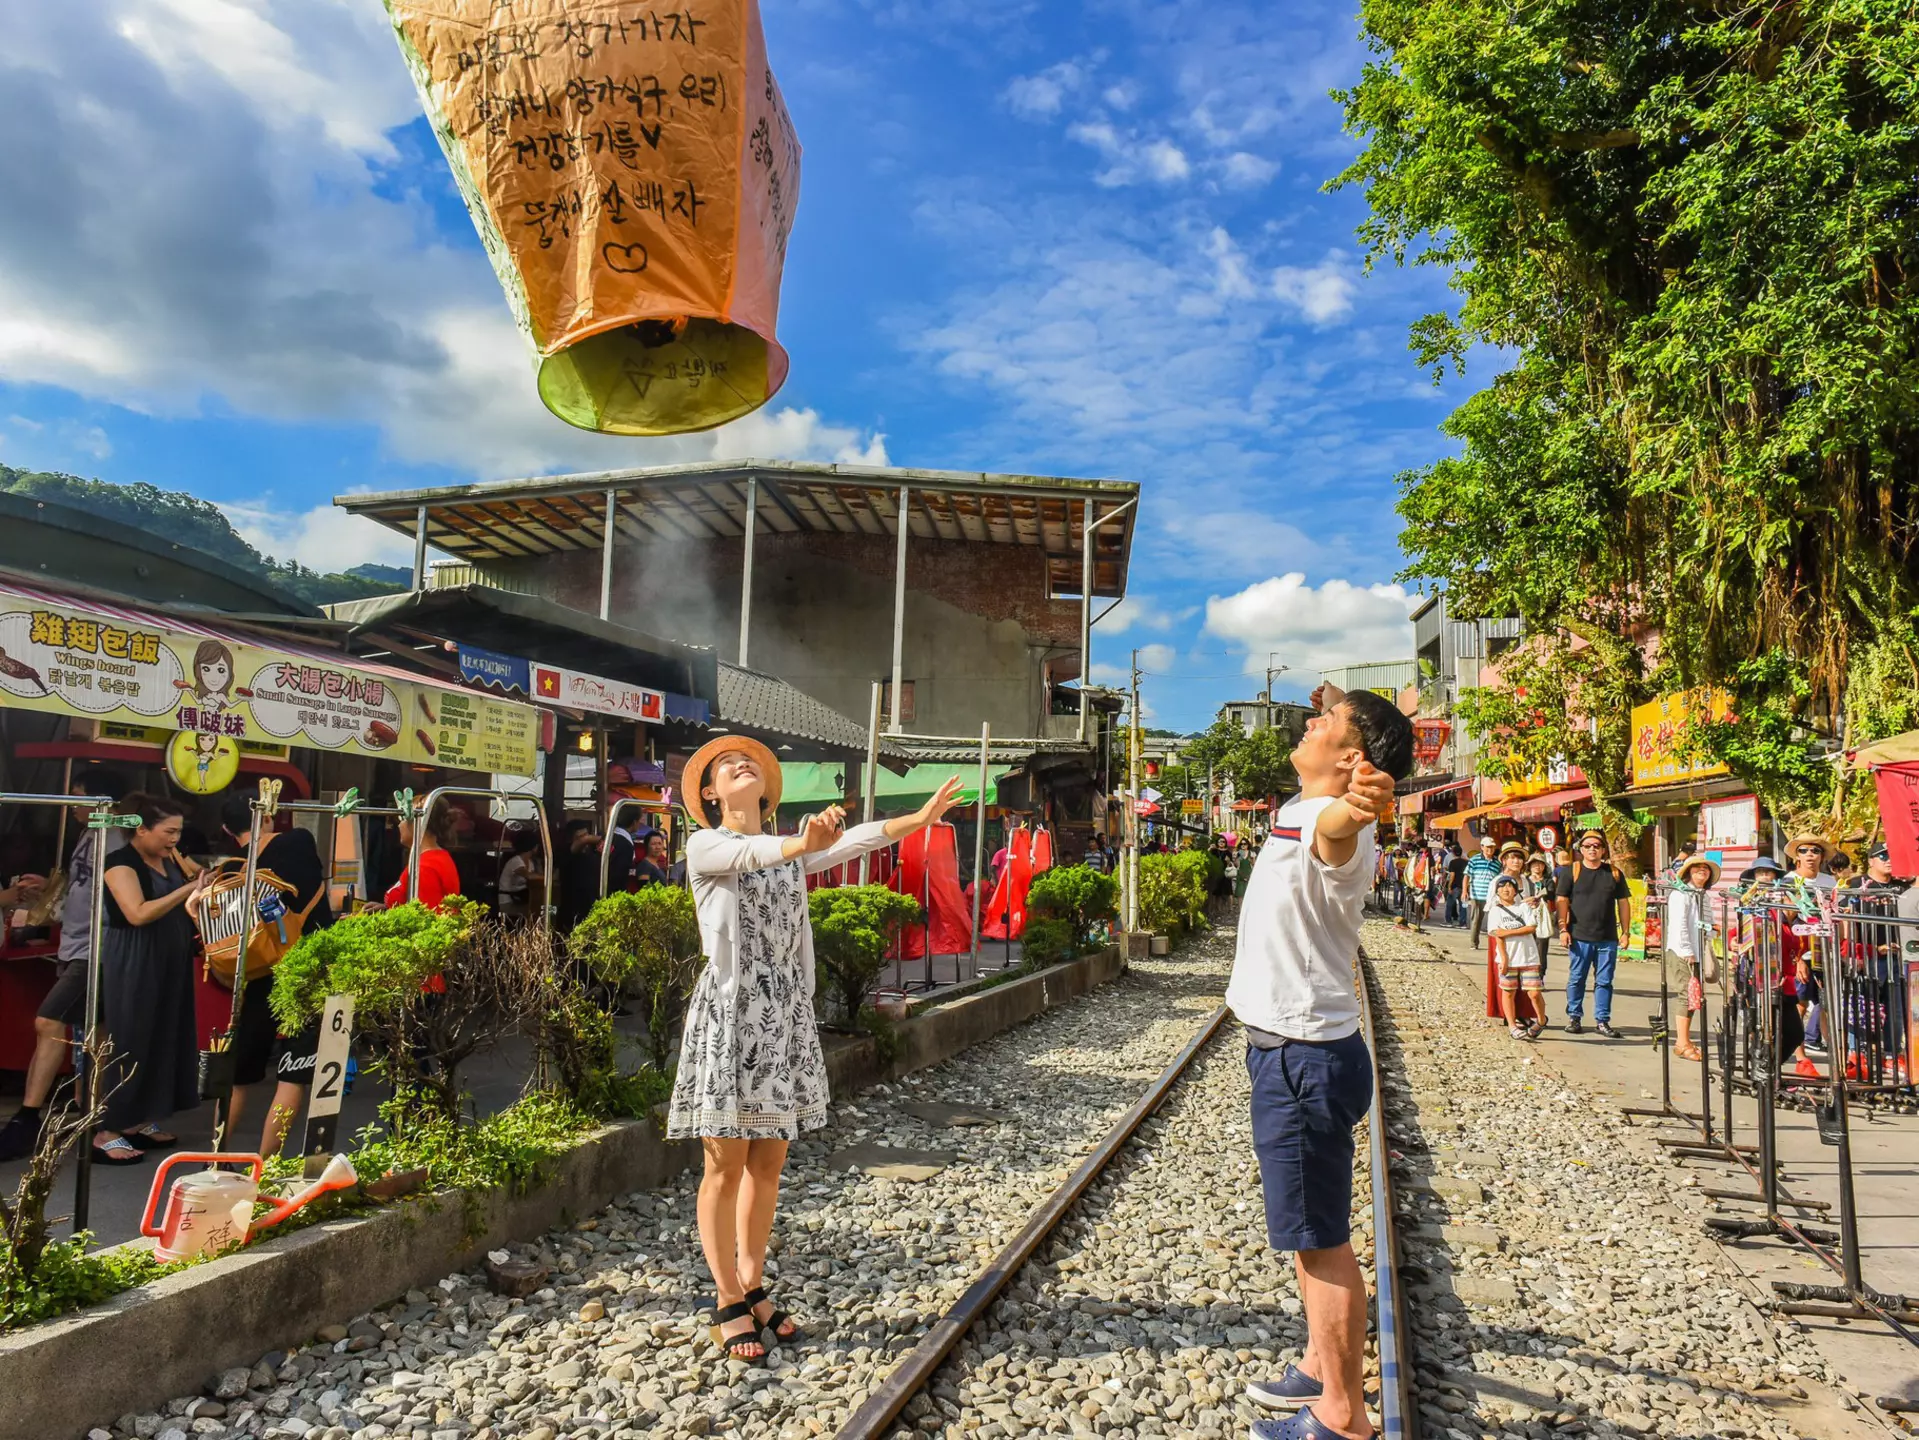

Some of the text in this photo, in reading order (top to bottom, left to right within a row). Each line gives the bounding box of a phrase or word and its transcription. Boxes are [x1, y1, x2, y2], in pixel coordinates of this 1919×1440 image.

[557, 9, 706, 59] 장가가자
[30, 610, 161, 666] 雞翅包飯
[48, 667, 141, 697] 닭날개 볶음밥
[55, 651, 136, 677] Wings board
[275, 661, 384, 707] 大腸包小腸
[256, 687, 398, 723] Small Sausage in Large Sausage
[1425, 833, 1443, 843] 150
[277, 1051, 318, 1074] Craz
[316, 1061, 341, 1099] 2
